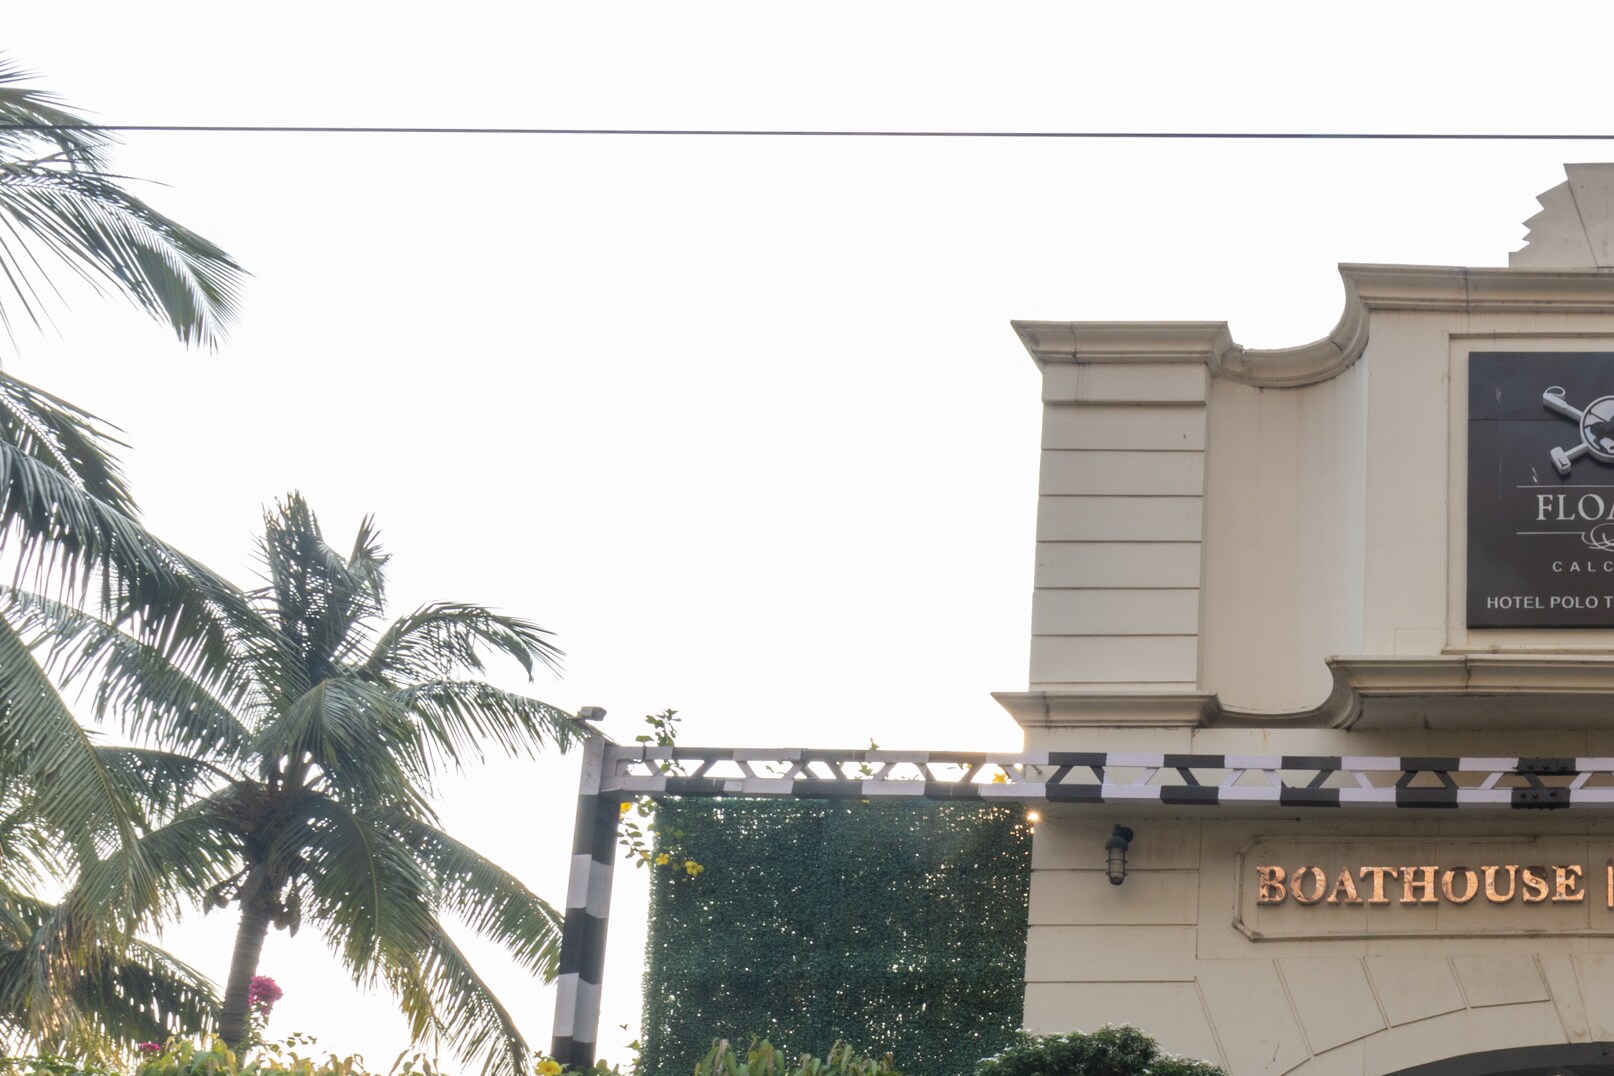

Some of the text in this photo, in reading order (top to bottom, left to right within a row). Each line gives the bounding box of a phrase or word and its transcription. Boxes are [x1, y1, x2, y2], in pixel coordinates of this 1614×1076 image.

[1487, 596, 1544, 609] HOTEL
[1550, 596, 1598, 609] POLO
[1256, 864, 1586, 905] BOATHOUSE
